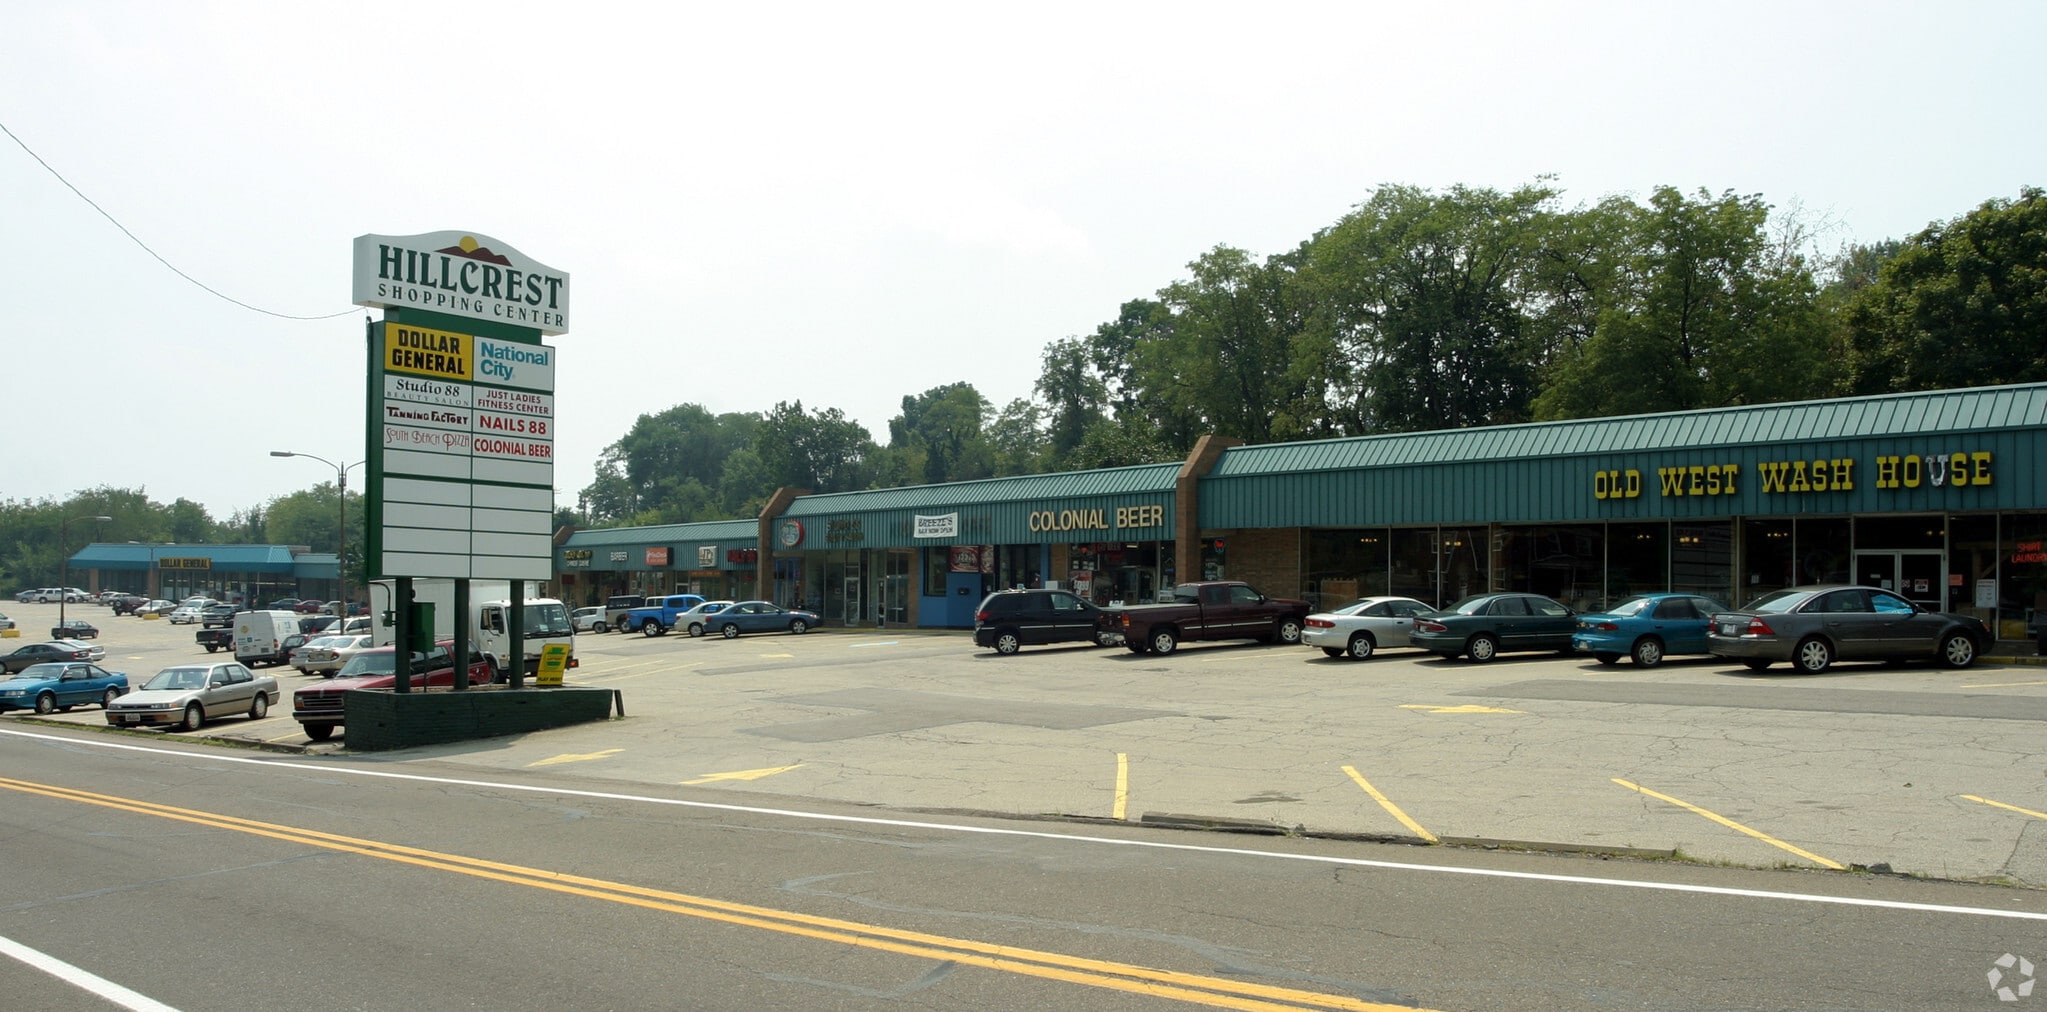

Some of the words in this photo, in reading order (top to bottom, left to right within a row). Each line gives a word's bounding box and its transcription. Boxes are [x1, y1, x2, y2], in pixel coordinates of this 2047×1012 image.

[378, 244, 562, 309] HILLCREST
[378, 283, 483, 313] SHOPPING
[494, 304, 563, 327] CENTER
[398, 329, 460, 354] DOLLAR
[392, 348, 465, 375] GENERAL
[481, 342, 548, 366] National
[480, 359, 513, 380] City
[396, 379, 442, 395] Studio
[444, 385, 460, 397] 88
[487, 390, 508, 400] JUST
[510, 392, 541, 404] LADIES
[387, 391, 429, 401] BEAUTY
[435, 397, 469, 406] SALON
[478, 399, 513, 410] FITNESS
[516, 403, 549, 415] CENTER
[480, 415, 525, 433] NAILS
[528, 421, 546, 435] 88
[442, 433, 470, 451] PIZZA
[474, 438, 526, 456] COLONIAL
[528, 444, 551, 458] BEER
[1594, 469, 1641, 499] OLD
[1658, 464, 1738, 496] WEST
[1758, 459, 1853, 493] WASH
[1876, 452, 1991, 489] HOUSE
[919, 516, 953, 527] BREEZE'S
[1029, 509, 1109, 532] COLONIAL
[1116, 505, 1163, 529] BEER
[2016, 541, 2041, 552] SHIRT
[160, 558, 180, 568] DOLLAR
[183, 558, 209, 568] GENERAL
